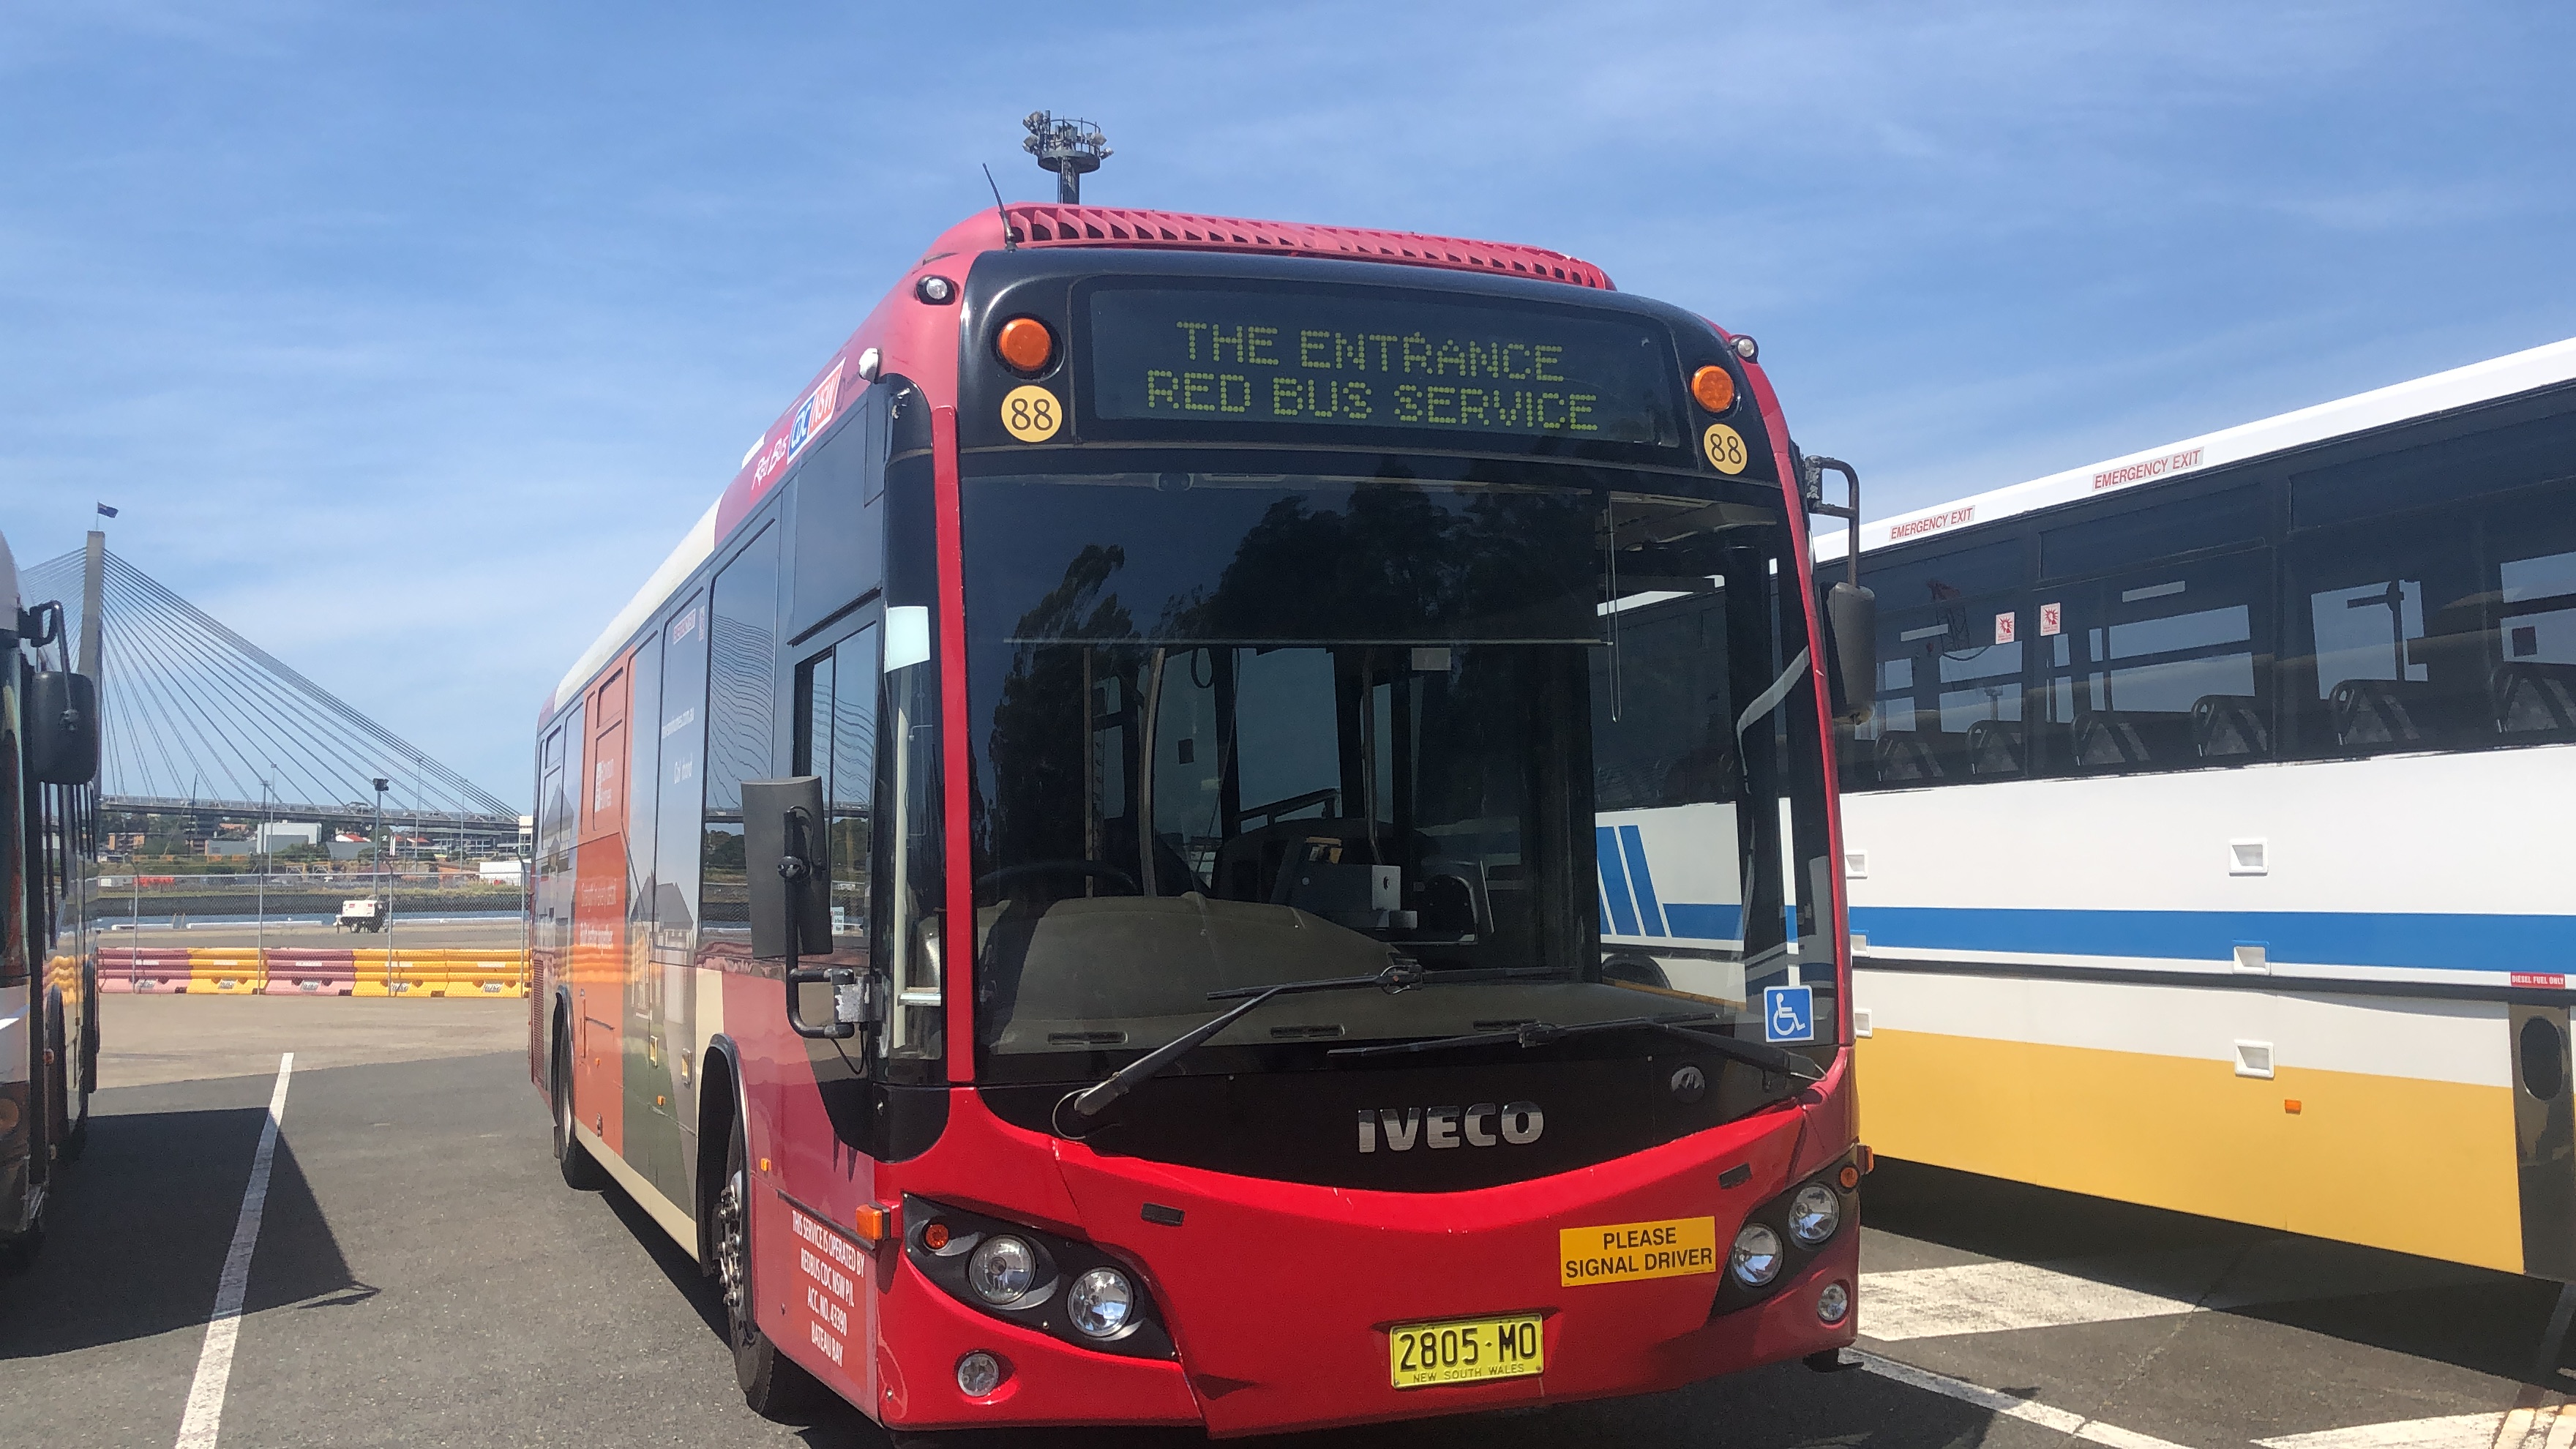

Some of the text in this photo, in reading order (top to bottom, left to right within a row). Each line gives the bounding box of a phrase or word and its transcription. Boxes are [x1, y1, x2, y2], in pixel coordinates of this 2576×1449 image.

[1176, 321, 1565, 383] THE ENTRANCE
[1011, 398, 1053, 430] 88
[1147, 370, 1598, 432] RED BUS SERVICE
[1710, 433, 1742, 464] 88
[2094, 449, 2201, 489] EMERGENCY EXIT
[1890, 506, 1974, 540] EMERGENCY EXIT
[2512, 975, 2564, 985] DIESEL FUEL ONLY
[1358, 1101, 1544, 1153] IVECO
[792, 1210, 866, 1278] THIS SERVICE IS OPERATED BY
[1603, 1227, 1677, 1251] PLEASE
[801, 1247, 821, 1281] REDBUS
[820, 1261, 833, 1291] CDC
[832, 1268, 846, 1300] NSW
[1565, 1247, 1713, 1279] SIGNAL DRIVER
[807, 1285, 848, 1337] ACC. NO. 43390
[811, 1320, 844, 1368] BATEAU BAY
[1413, 1363, 1525, 1383] NEW SOUTH WALES
